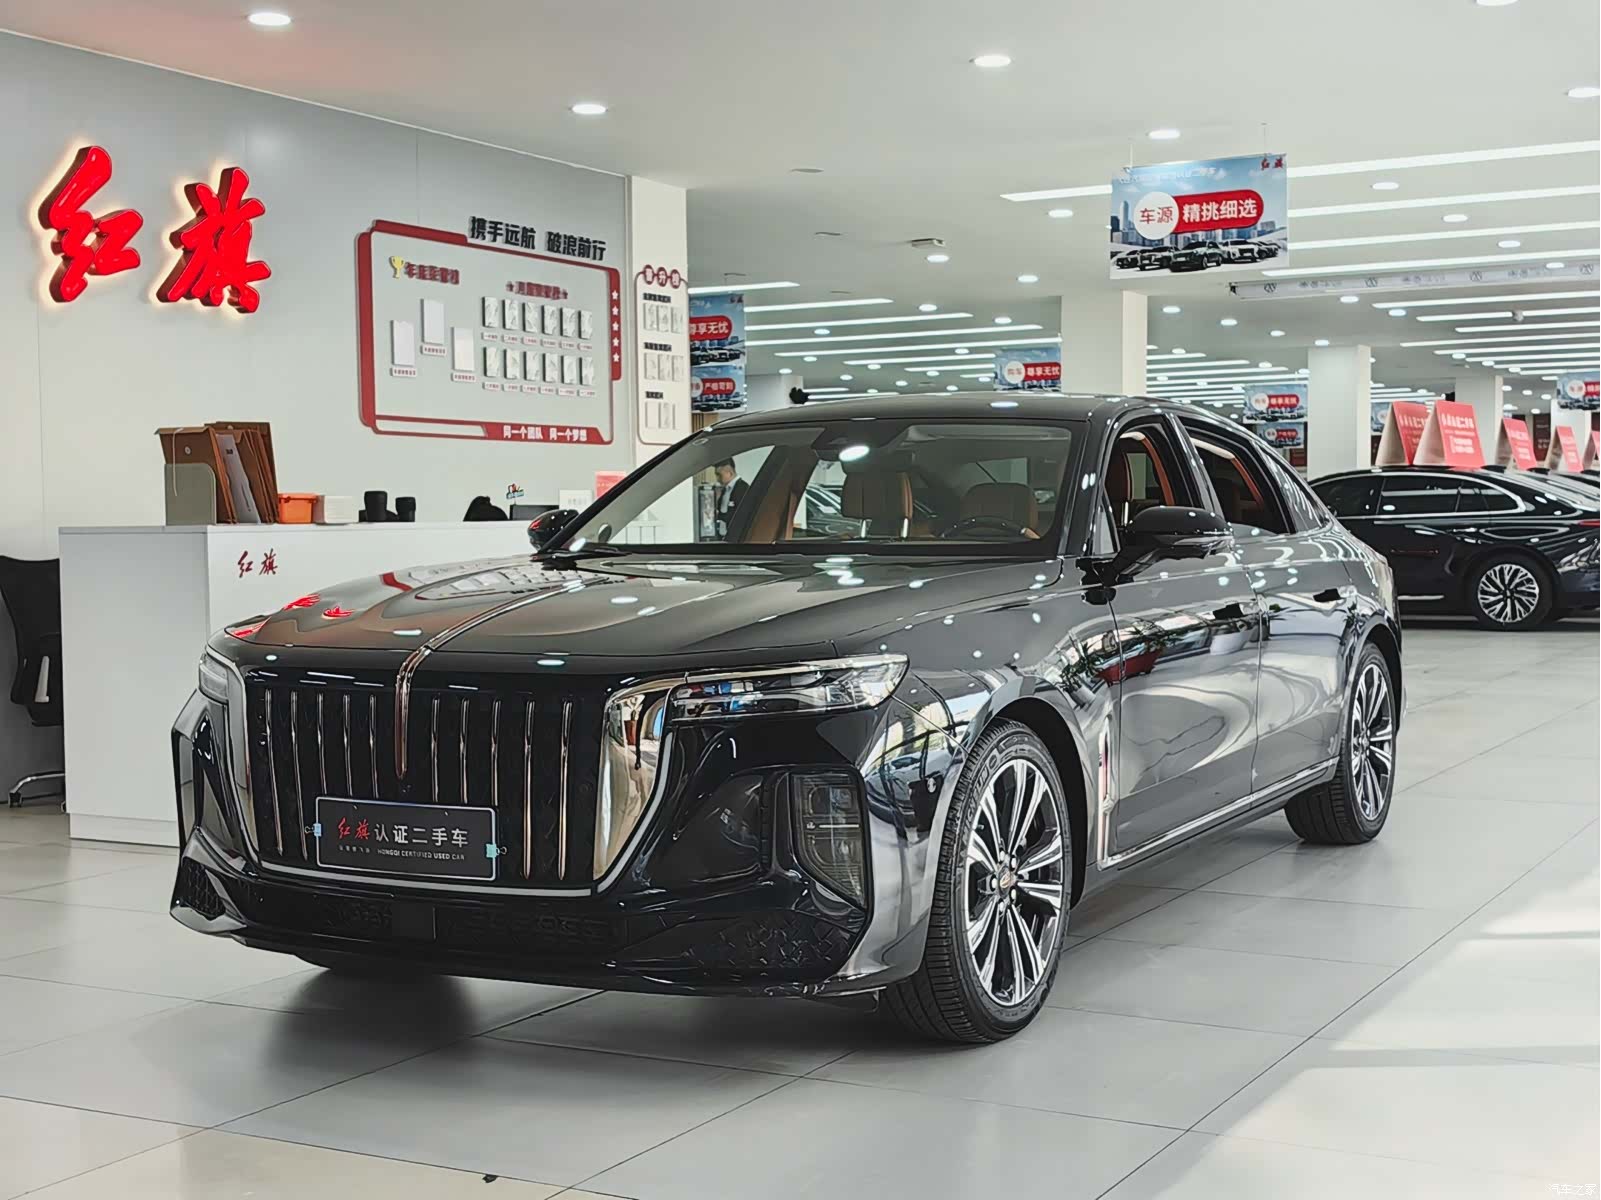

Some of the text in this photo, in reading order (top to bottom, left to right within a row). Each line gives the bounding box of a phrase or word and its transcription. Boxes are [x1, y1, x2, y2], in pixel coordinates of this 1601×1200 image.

[1139, 198, 1258, 224] 车源 精挑细选
[38, 145, 272, 314] 红旗
[469, 216, 607, 261] 携手远航 破浪前行
[503, 424, 544, 440] 同一个团队
[237, 548, 278, 578] 红旗
[377, 848, 400, 857] HONGQI
[401, 849, 432, 859] CERTIFIED
[433, 852, 450, 860] USED
[451, 853, 465, 861] CAR
